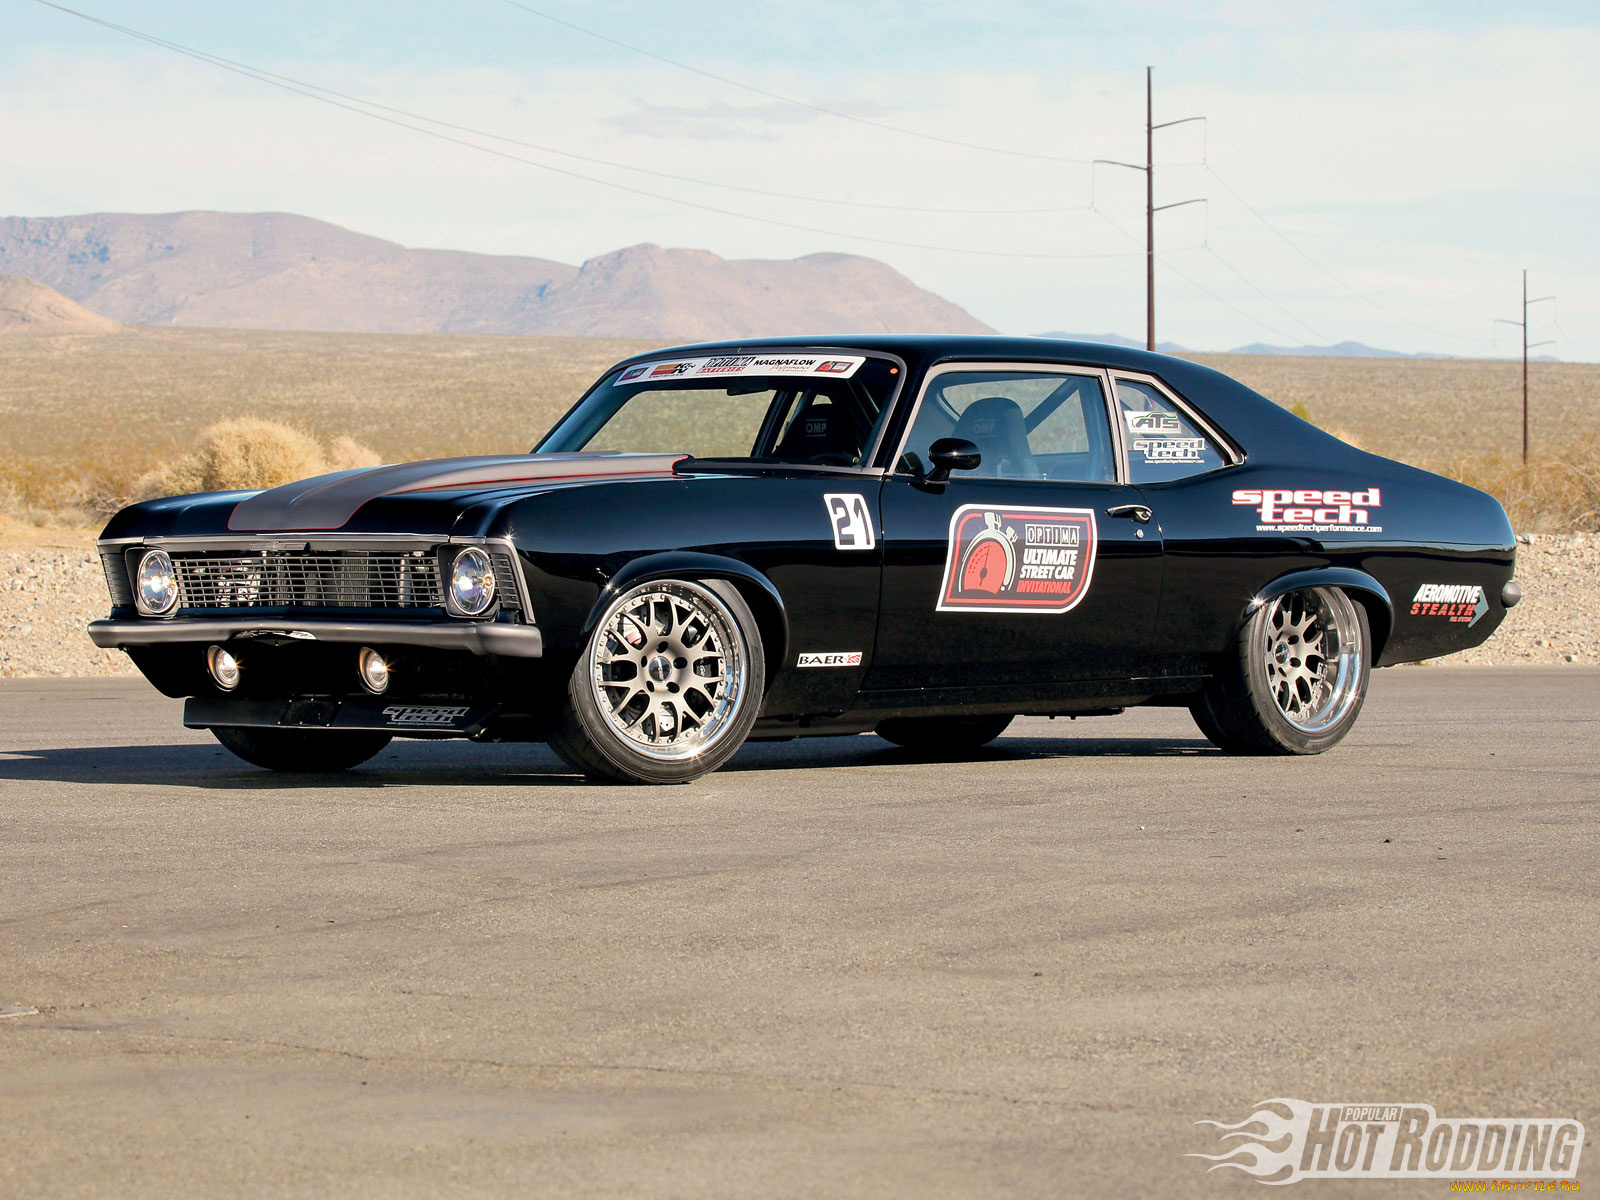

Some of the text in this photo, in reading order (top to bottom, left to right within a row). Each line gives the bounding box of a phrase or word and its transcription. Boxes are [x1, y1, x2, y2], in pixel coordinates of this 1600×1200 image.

[805, 422, 827, 433] OMP
[1135, 413, 1179, 429] ATS
[1231, 487, 1382, 508] speed
[830, 497, 871, 546] 21
[1256, 504, 1369, 524] tech
[1026, 525, 1079, 546] OPTIMA
[1255, 524, 1383, 533] www.speedtechperformance.com
[1022, 548, 1079, 566] ULTIMATE
[1019, 565, 1075, 580] STREET CAR
[1016, 580, 1072, 594] INVITATIONAL
[1412, 583, 1482, 604] AEROMOTIVE
[1409, 602, 1477, 616] STEALTH
[798, 655, 844, 665] BAER
